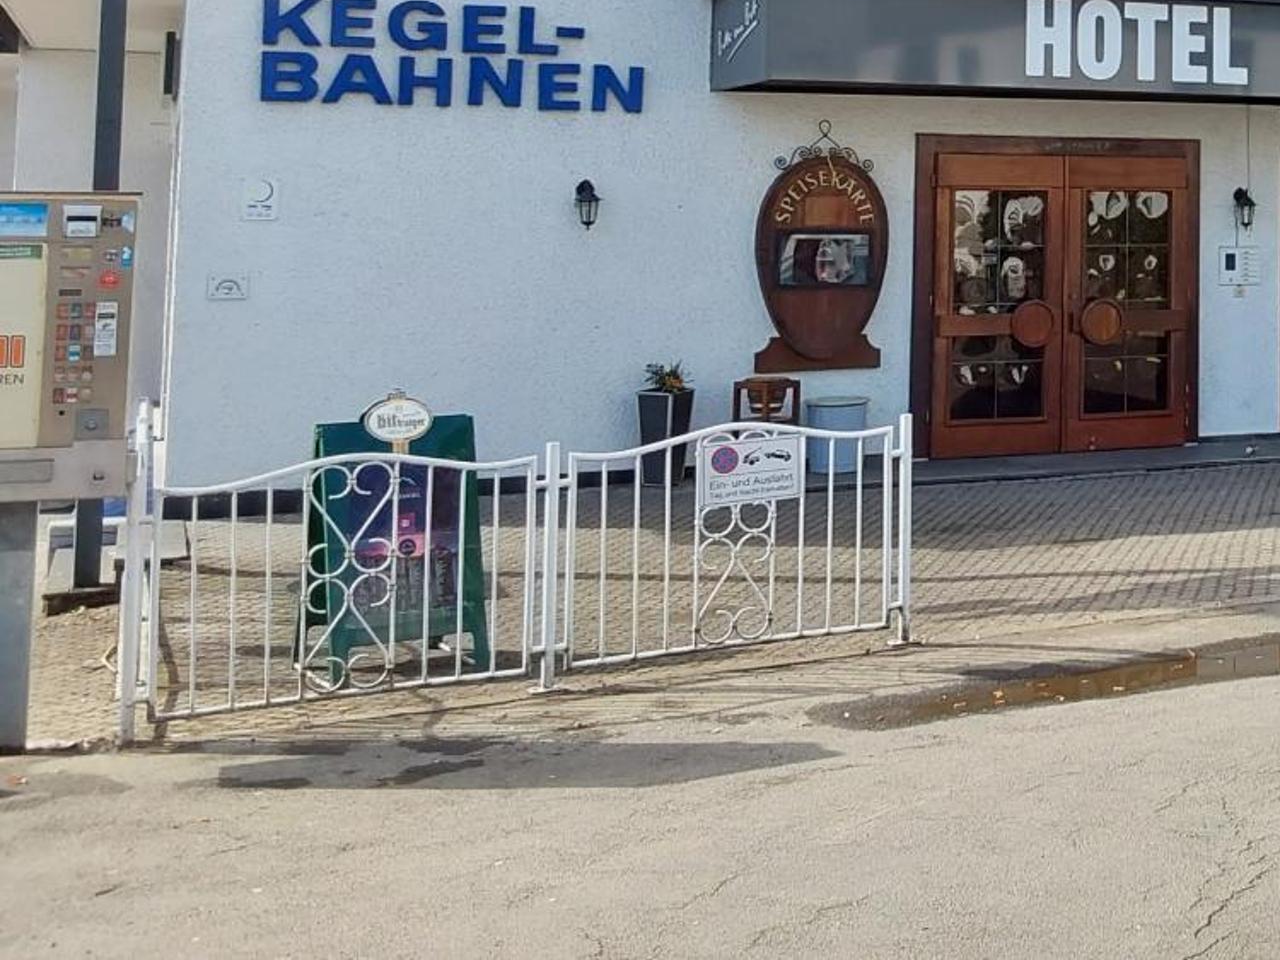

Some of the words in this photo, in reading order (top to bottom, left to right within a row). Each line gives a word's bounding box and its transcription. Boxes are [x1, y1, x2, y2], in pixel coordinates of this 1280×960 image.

[260, 51, 645, 113] BAHNEN
[775, 169, 875, 226] SPEISEKARTE
[732, 478, 750, 487] und
[753, 473, 793, 485] Ausfahrt
